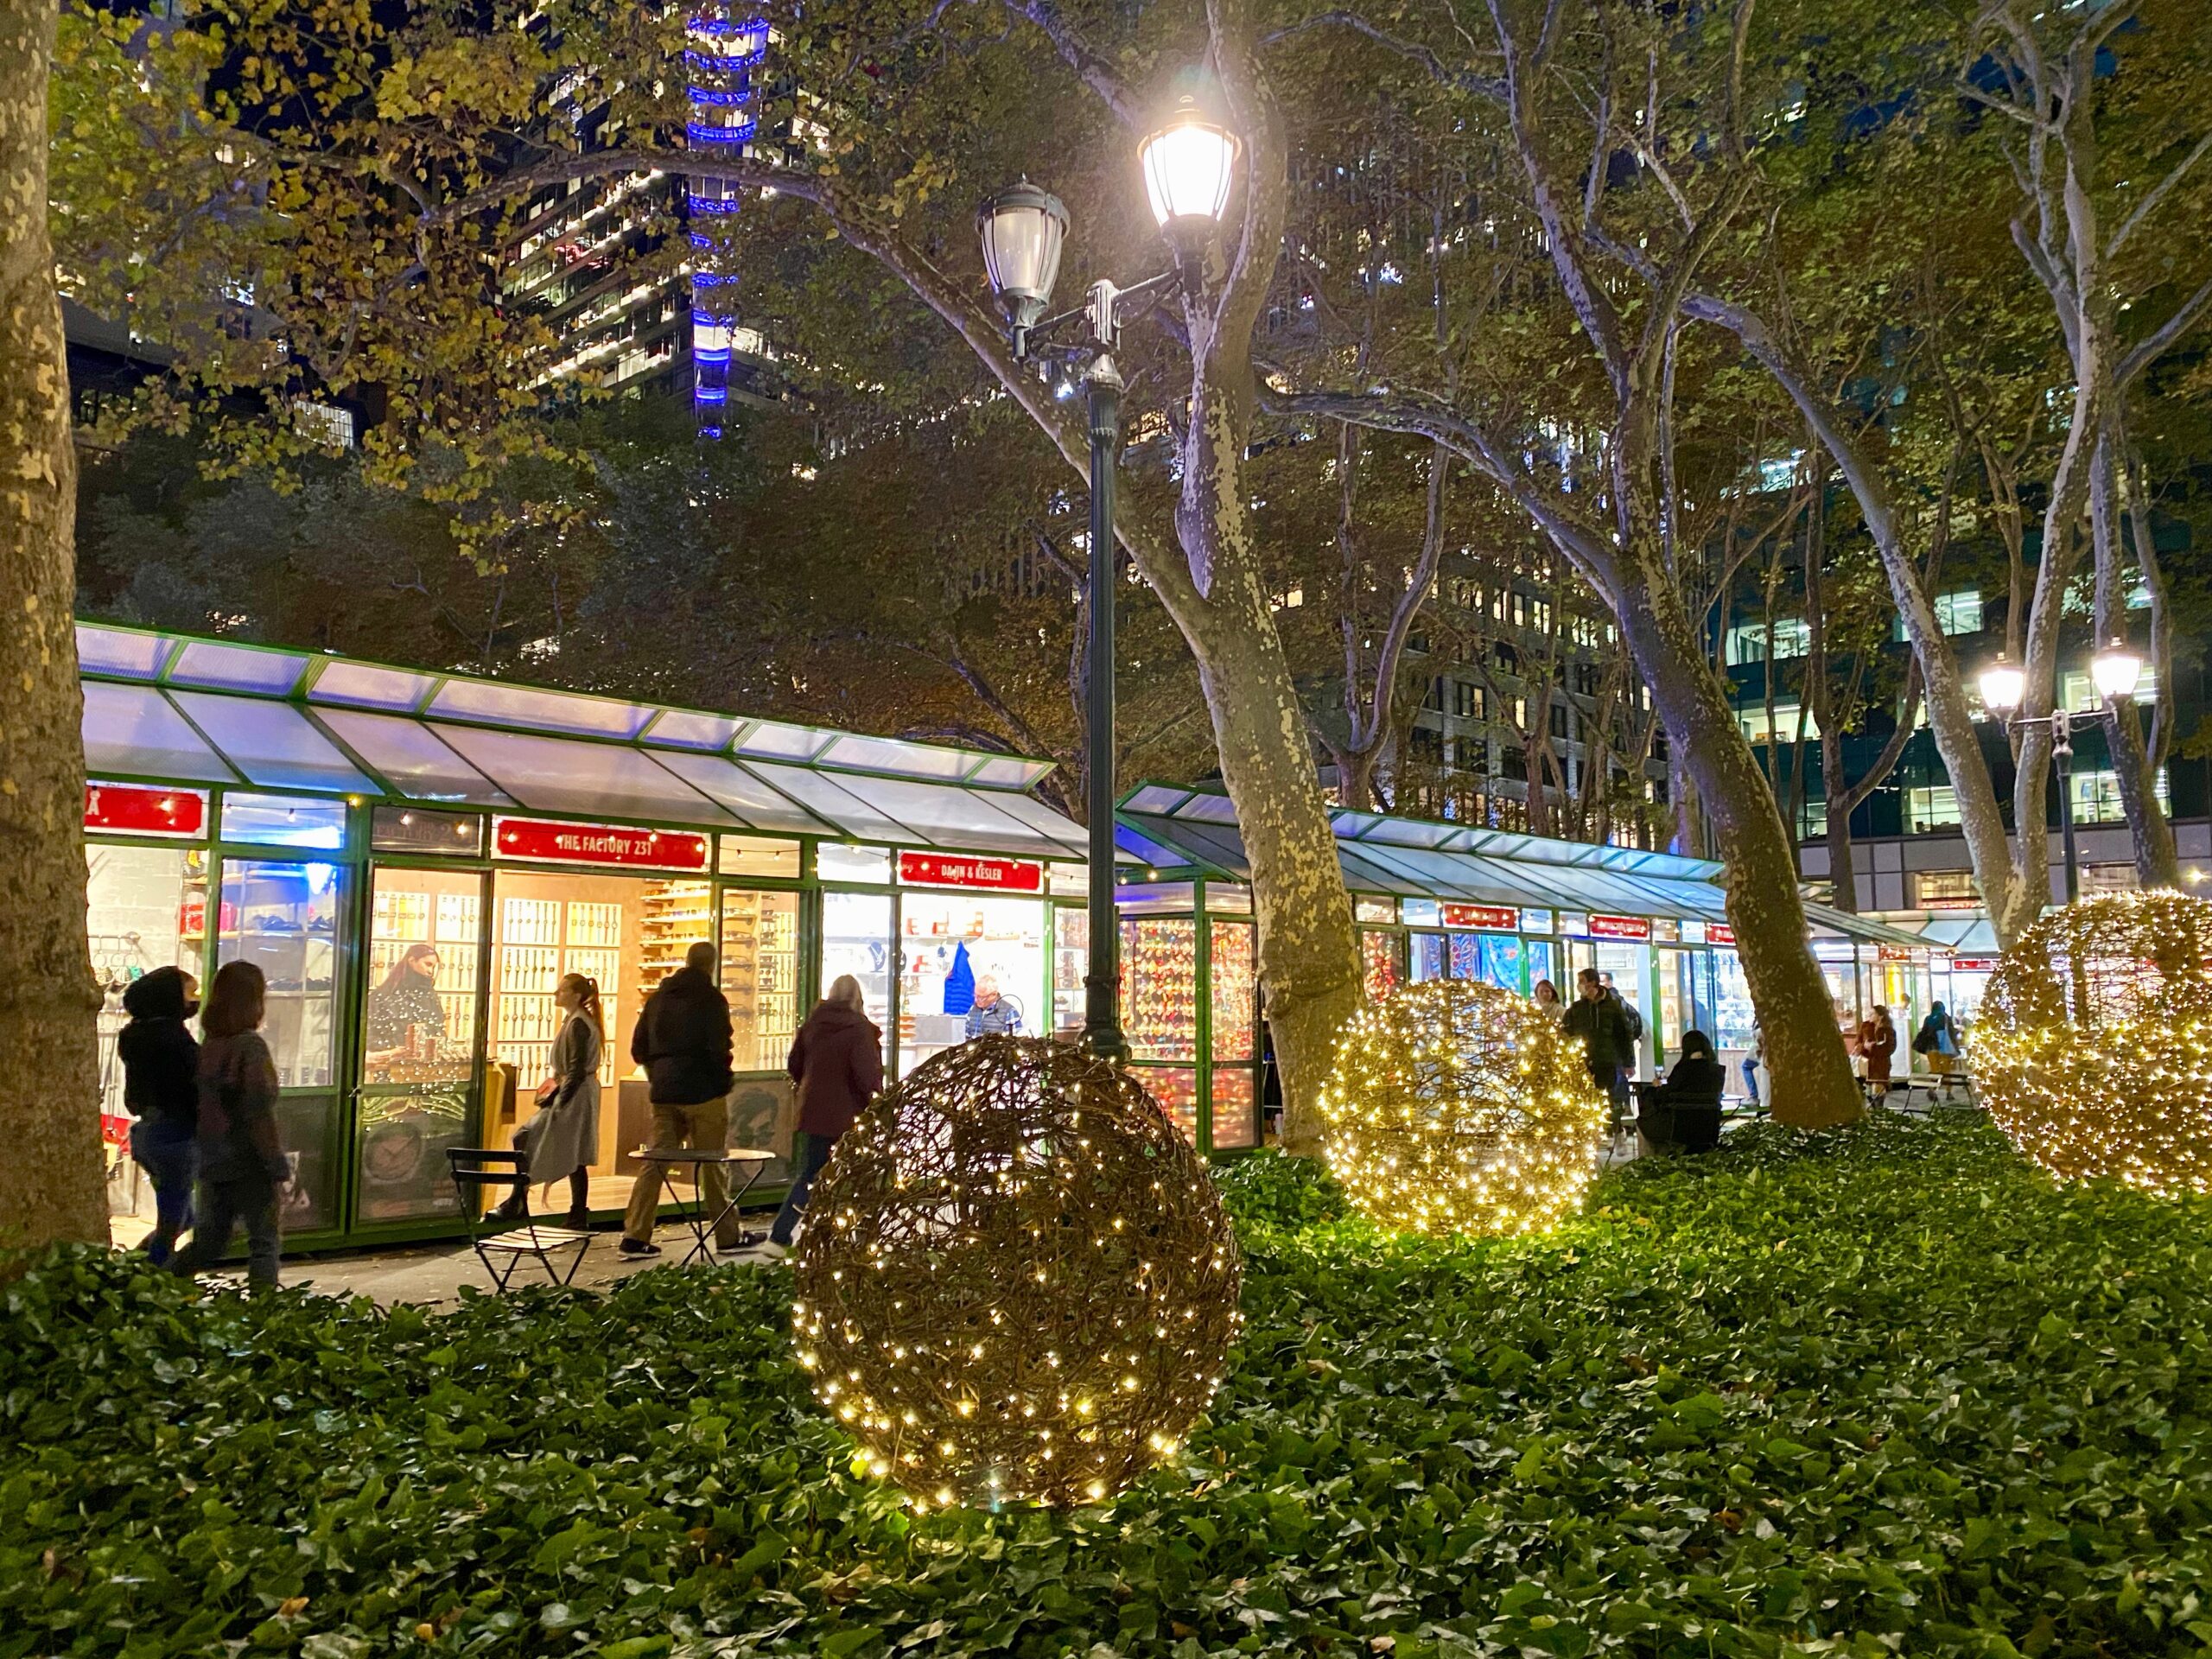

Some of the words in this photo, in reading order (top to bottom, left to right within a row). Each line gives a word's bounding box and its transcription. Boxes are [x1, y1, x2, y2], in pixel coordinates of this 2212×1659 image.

[557, 835, 580, 851] THE
[583, 836, 632, 855] FACTORY
[633, 840, 652, 856] 231
[967, 866, 974, 879] &
[975, 867, 1003, 881] KESLER
